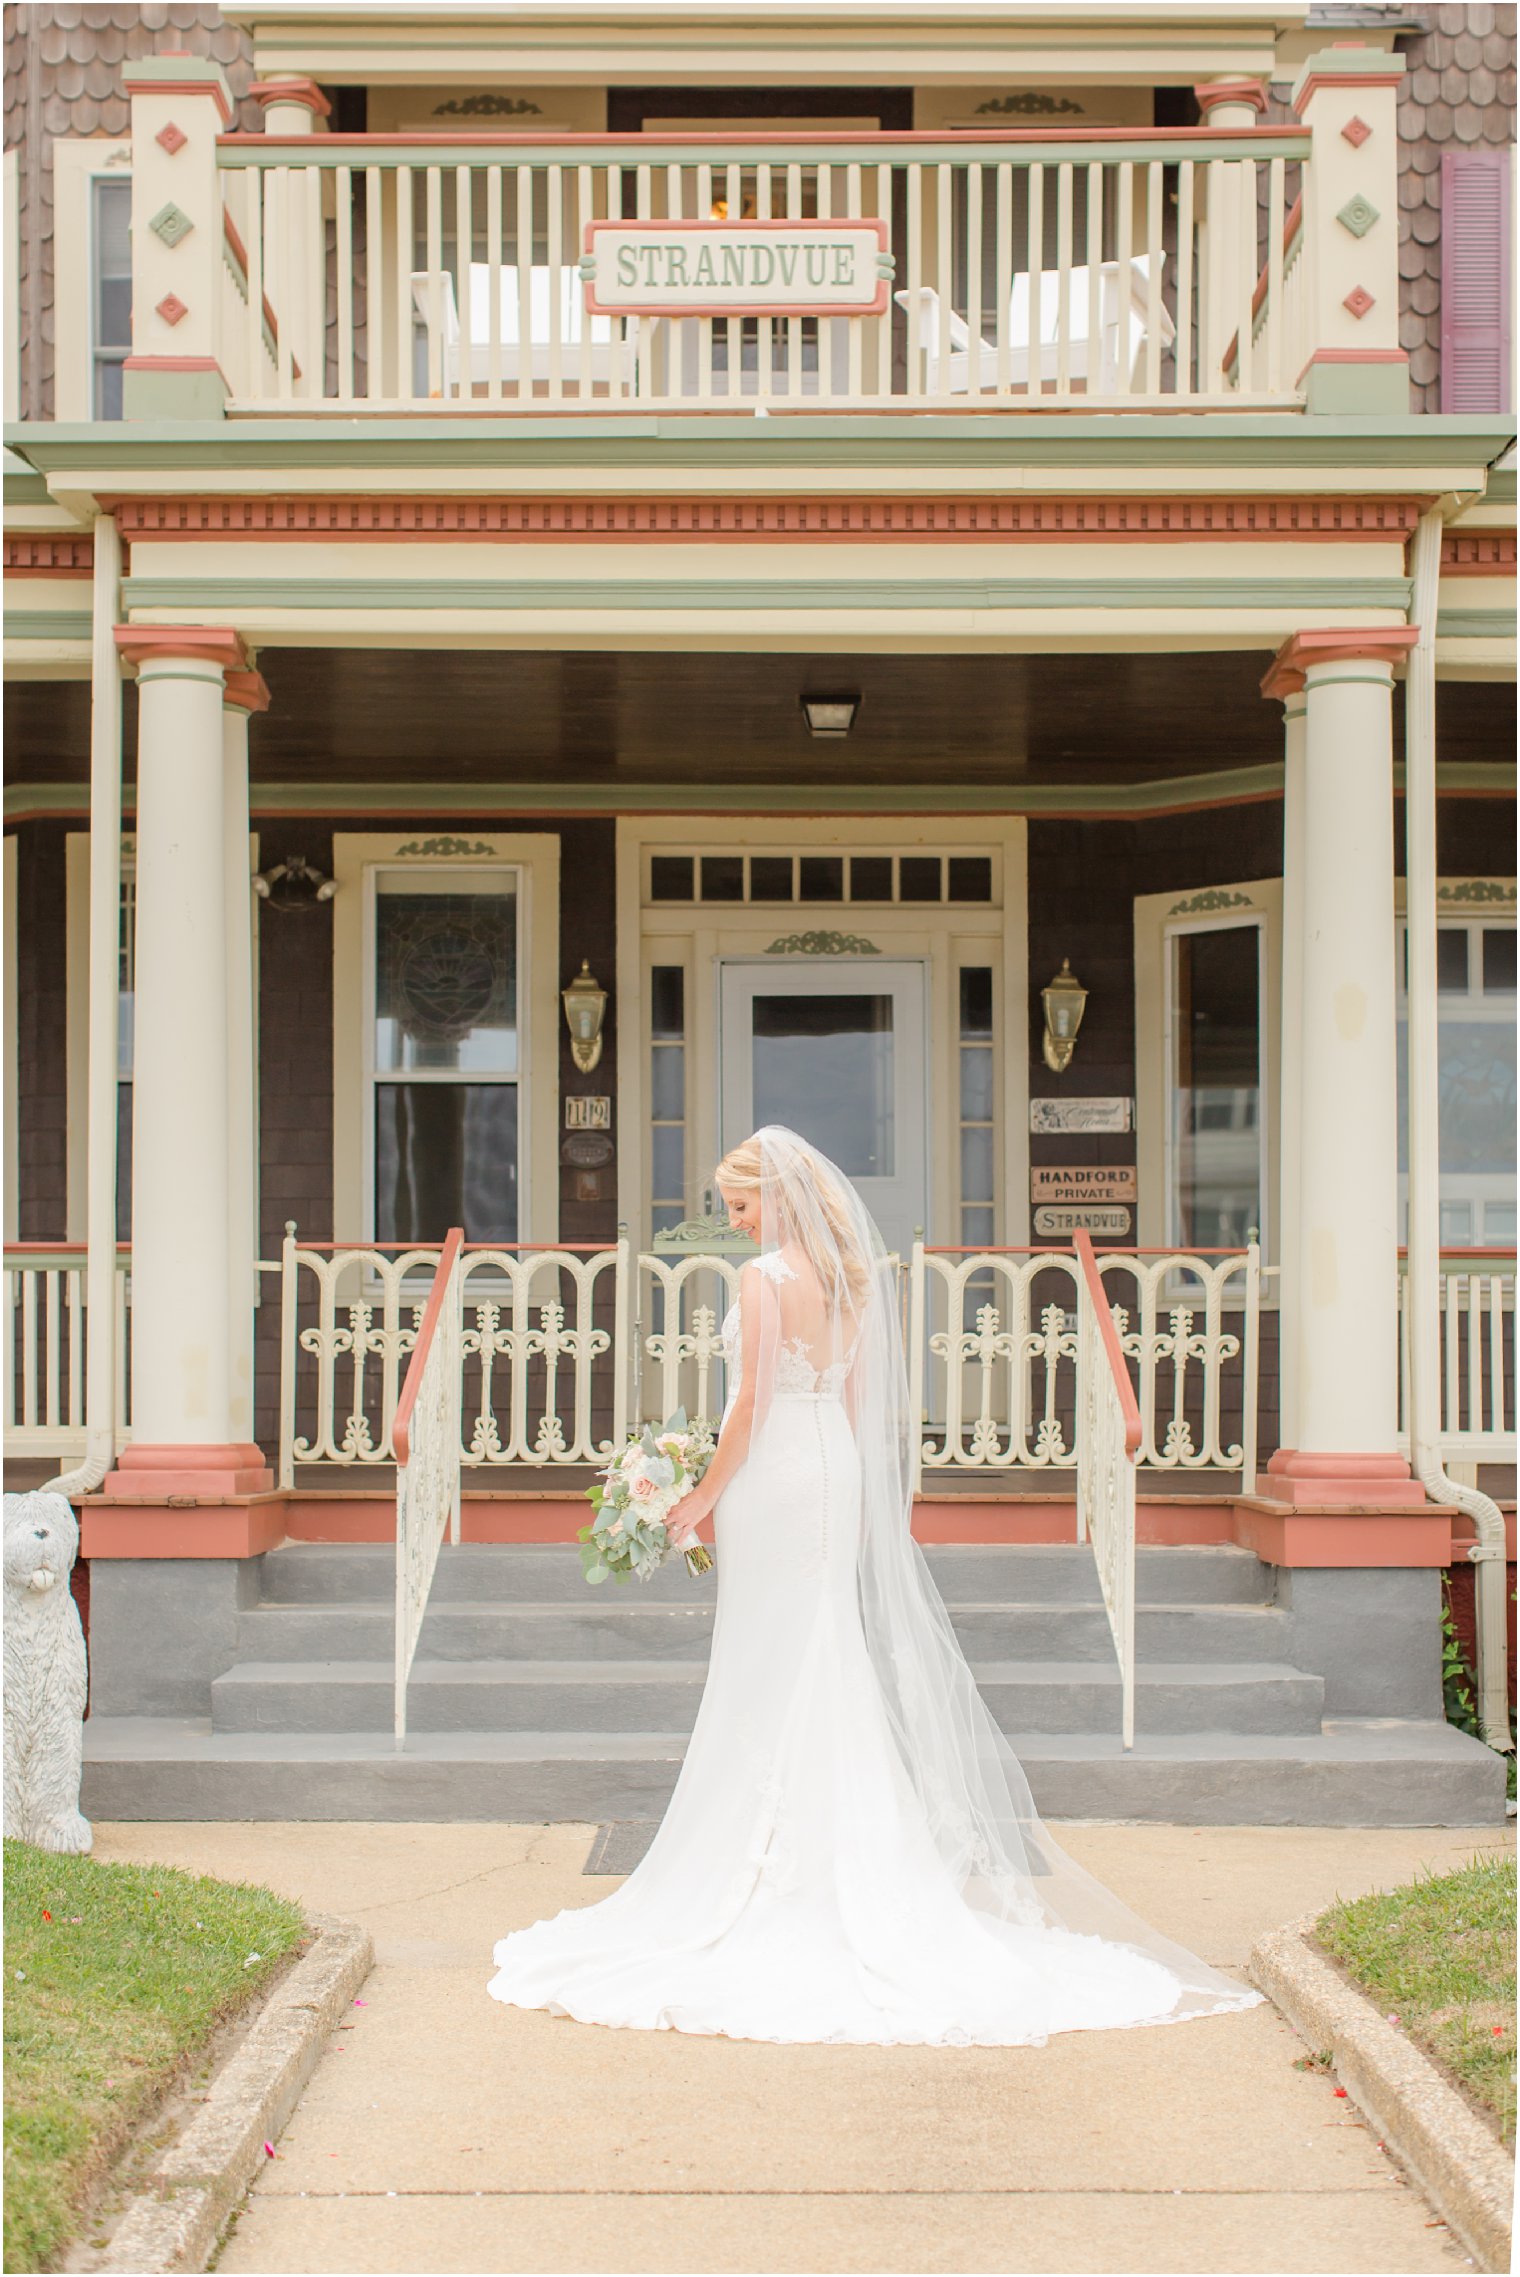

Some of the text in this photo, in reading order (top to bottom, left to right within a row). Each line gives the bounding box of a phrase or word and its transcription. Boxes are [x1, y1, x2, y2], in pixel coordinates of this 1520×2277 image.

[617, 244, 855, 288] STRANDVUE
[1039, 1171, 1130, 1184] HANDFORD
[1054, 1188, 1115, 1198] PRIVATE
[1043, 1212, 1126, 1229] STRANDVUE
